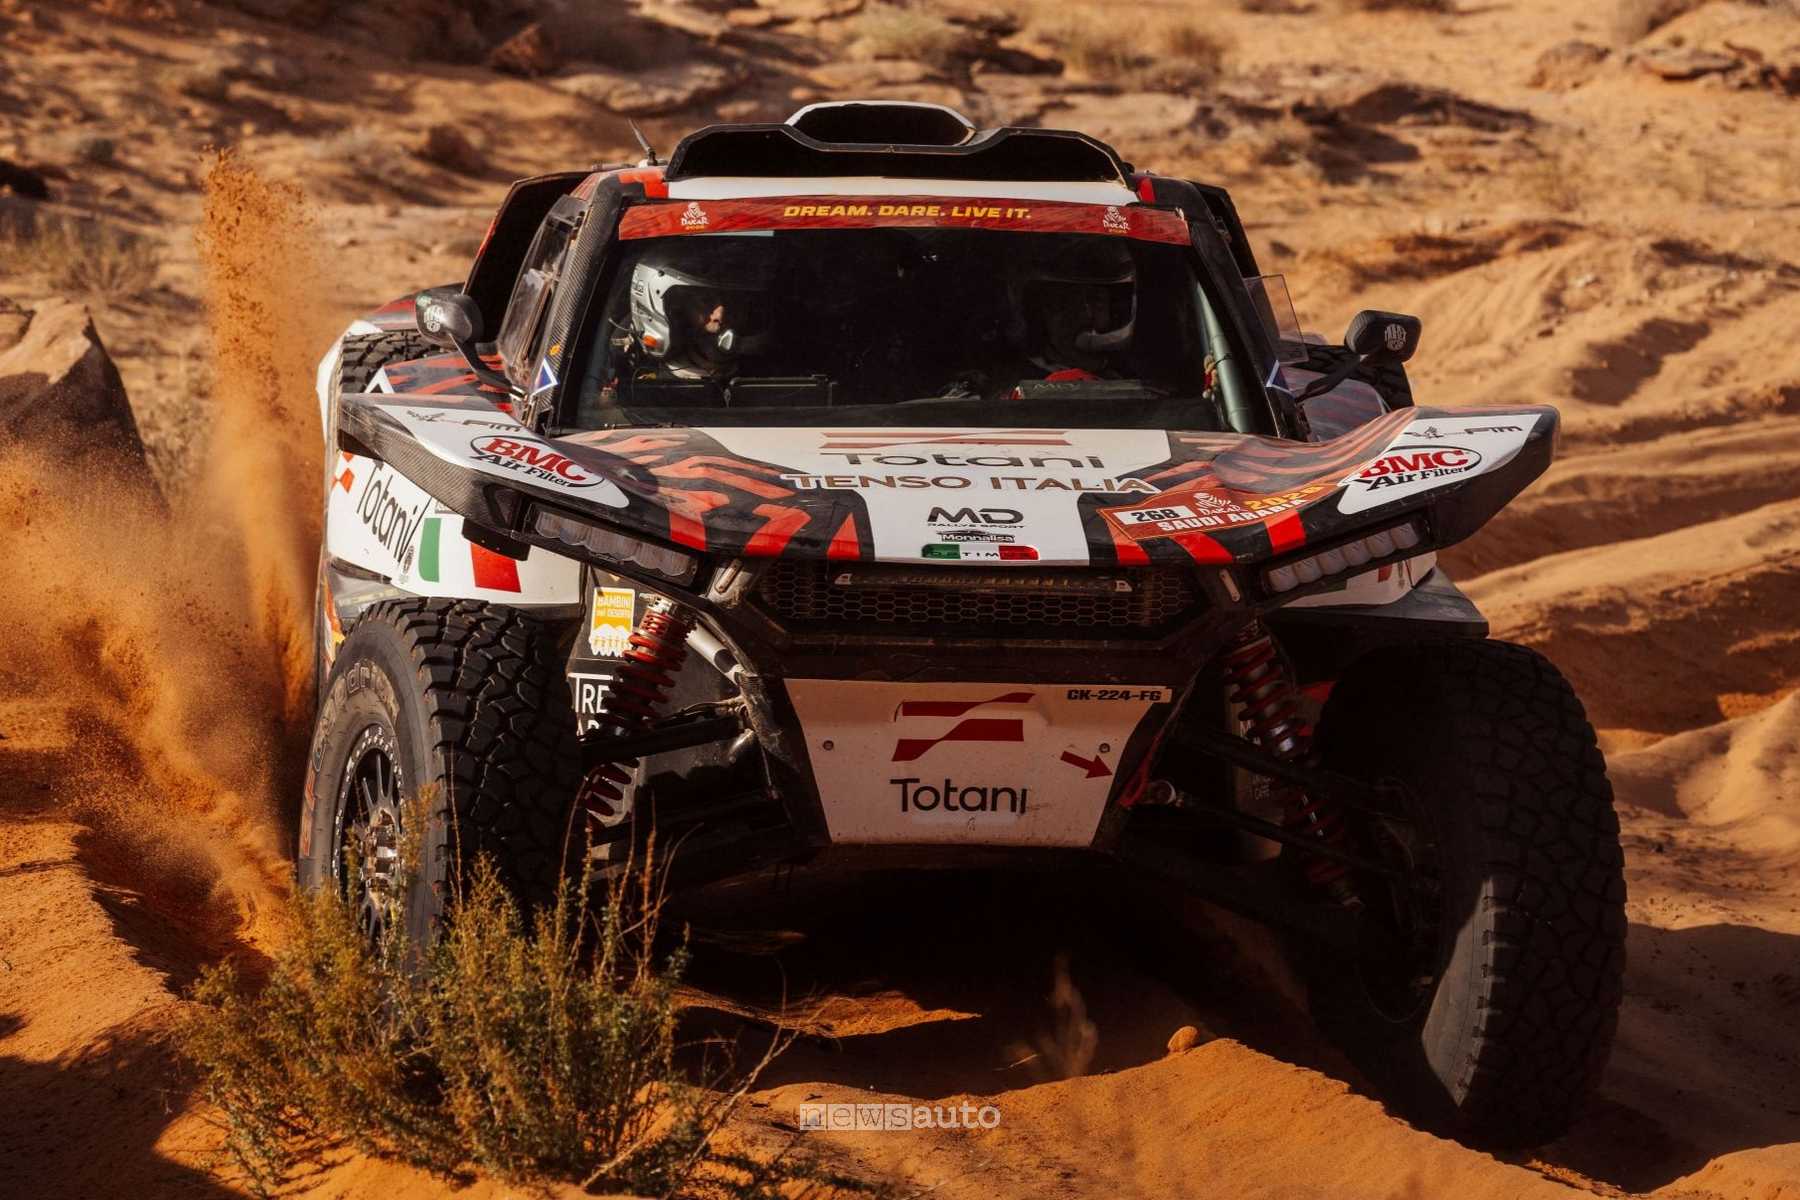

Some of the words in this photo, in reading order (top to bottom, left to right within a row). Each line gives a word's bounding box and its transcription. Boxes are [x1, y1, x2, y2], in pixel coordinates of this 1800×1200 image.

[784, 205, 873, 218] DREAM.
[878, 205, 946, 217] DARE.
[951, 206, 1001, 218] LIVE
[1006, 207, 1032, 219] IT.
[476, 454, 527, 471] Air
[527, 467, 571, 487] Filter
[480, 438, 587, 482] BMC
[820, 452, 1105, 469] Totani
[1360, 450, 1468, 478] BMC
[784, 474, 972, 490] TENSO
[989, 475, 1156, 492] ITALIA
[1358, 472, 1415, 491] Air
[1420, 466, 1463, 480] Filter
[356, 460, 418, 559] Totani
[927, 507, 1024, 524] MD
[1131, 509, 1179, 522] 268
[1158, 517, 1215, 532] SAUDI
[1228, 498, 1308, 524] ARABIA
[889, 778, 1027, 814] Totani
